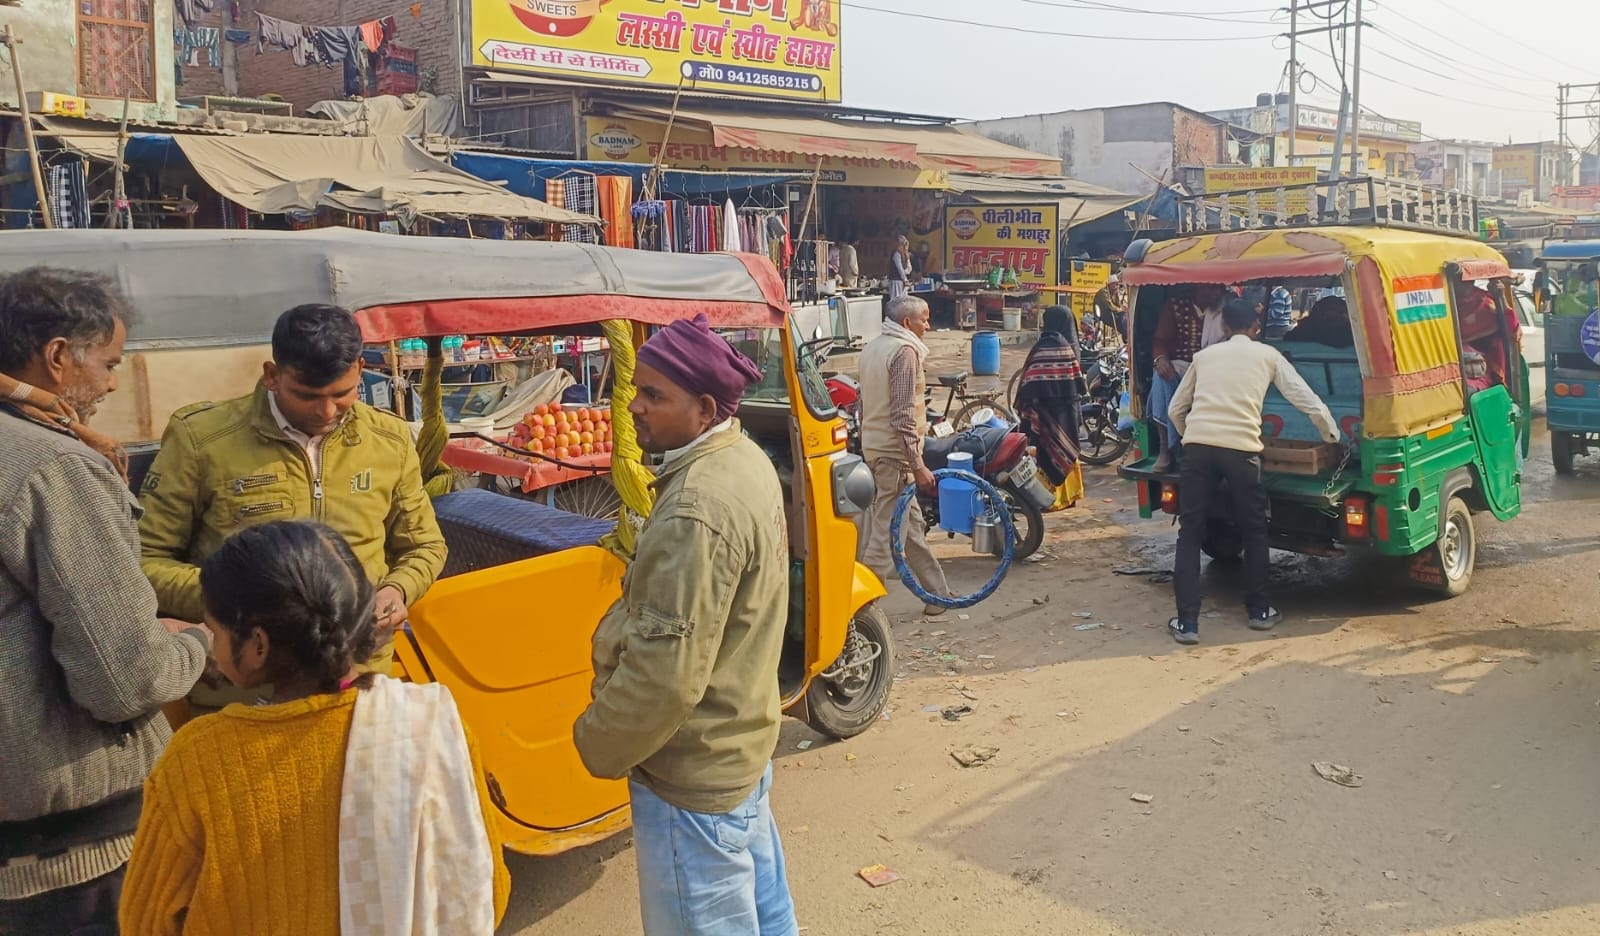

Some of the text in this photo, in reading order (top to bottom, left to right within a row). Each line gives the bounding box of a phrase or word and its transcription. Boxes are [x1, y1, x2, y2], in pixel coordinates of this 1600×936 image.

[527, 0, 577, 17] SWEETS
[617, 11, 686, 51] लस्सी
[692, 18, 731, 57] एवं
[733, 24, 781, 63] स्वीट
[784, 36, 835, 70] हाउस
[496, 44, 640, 73] देसी घी से निर्मित
[727, 71, 809, 90] 9412585215
[598, 136, 635, 146] BADNAM
[982, 208, 1042, 224] पीलीभीत
[996, 225, 1051, 244] की मशहूर
[1406, 291, 1433, 306] INDIA
